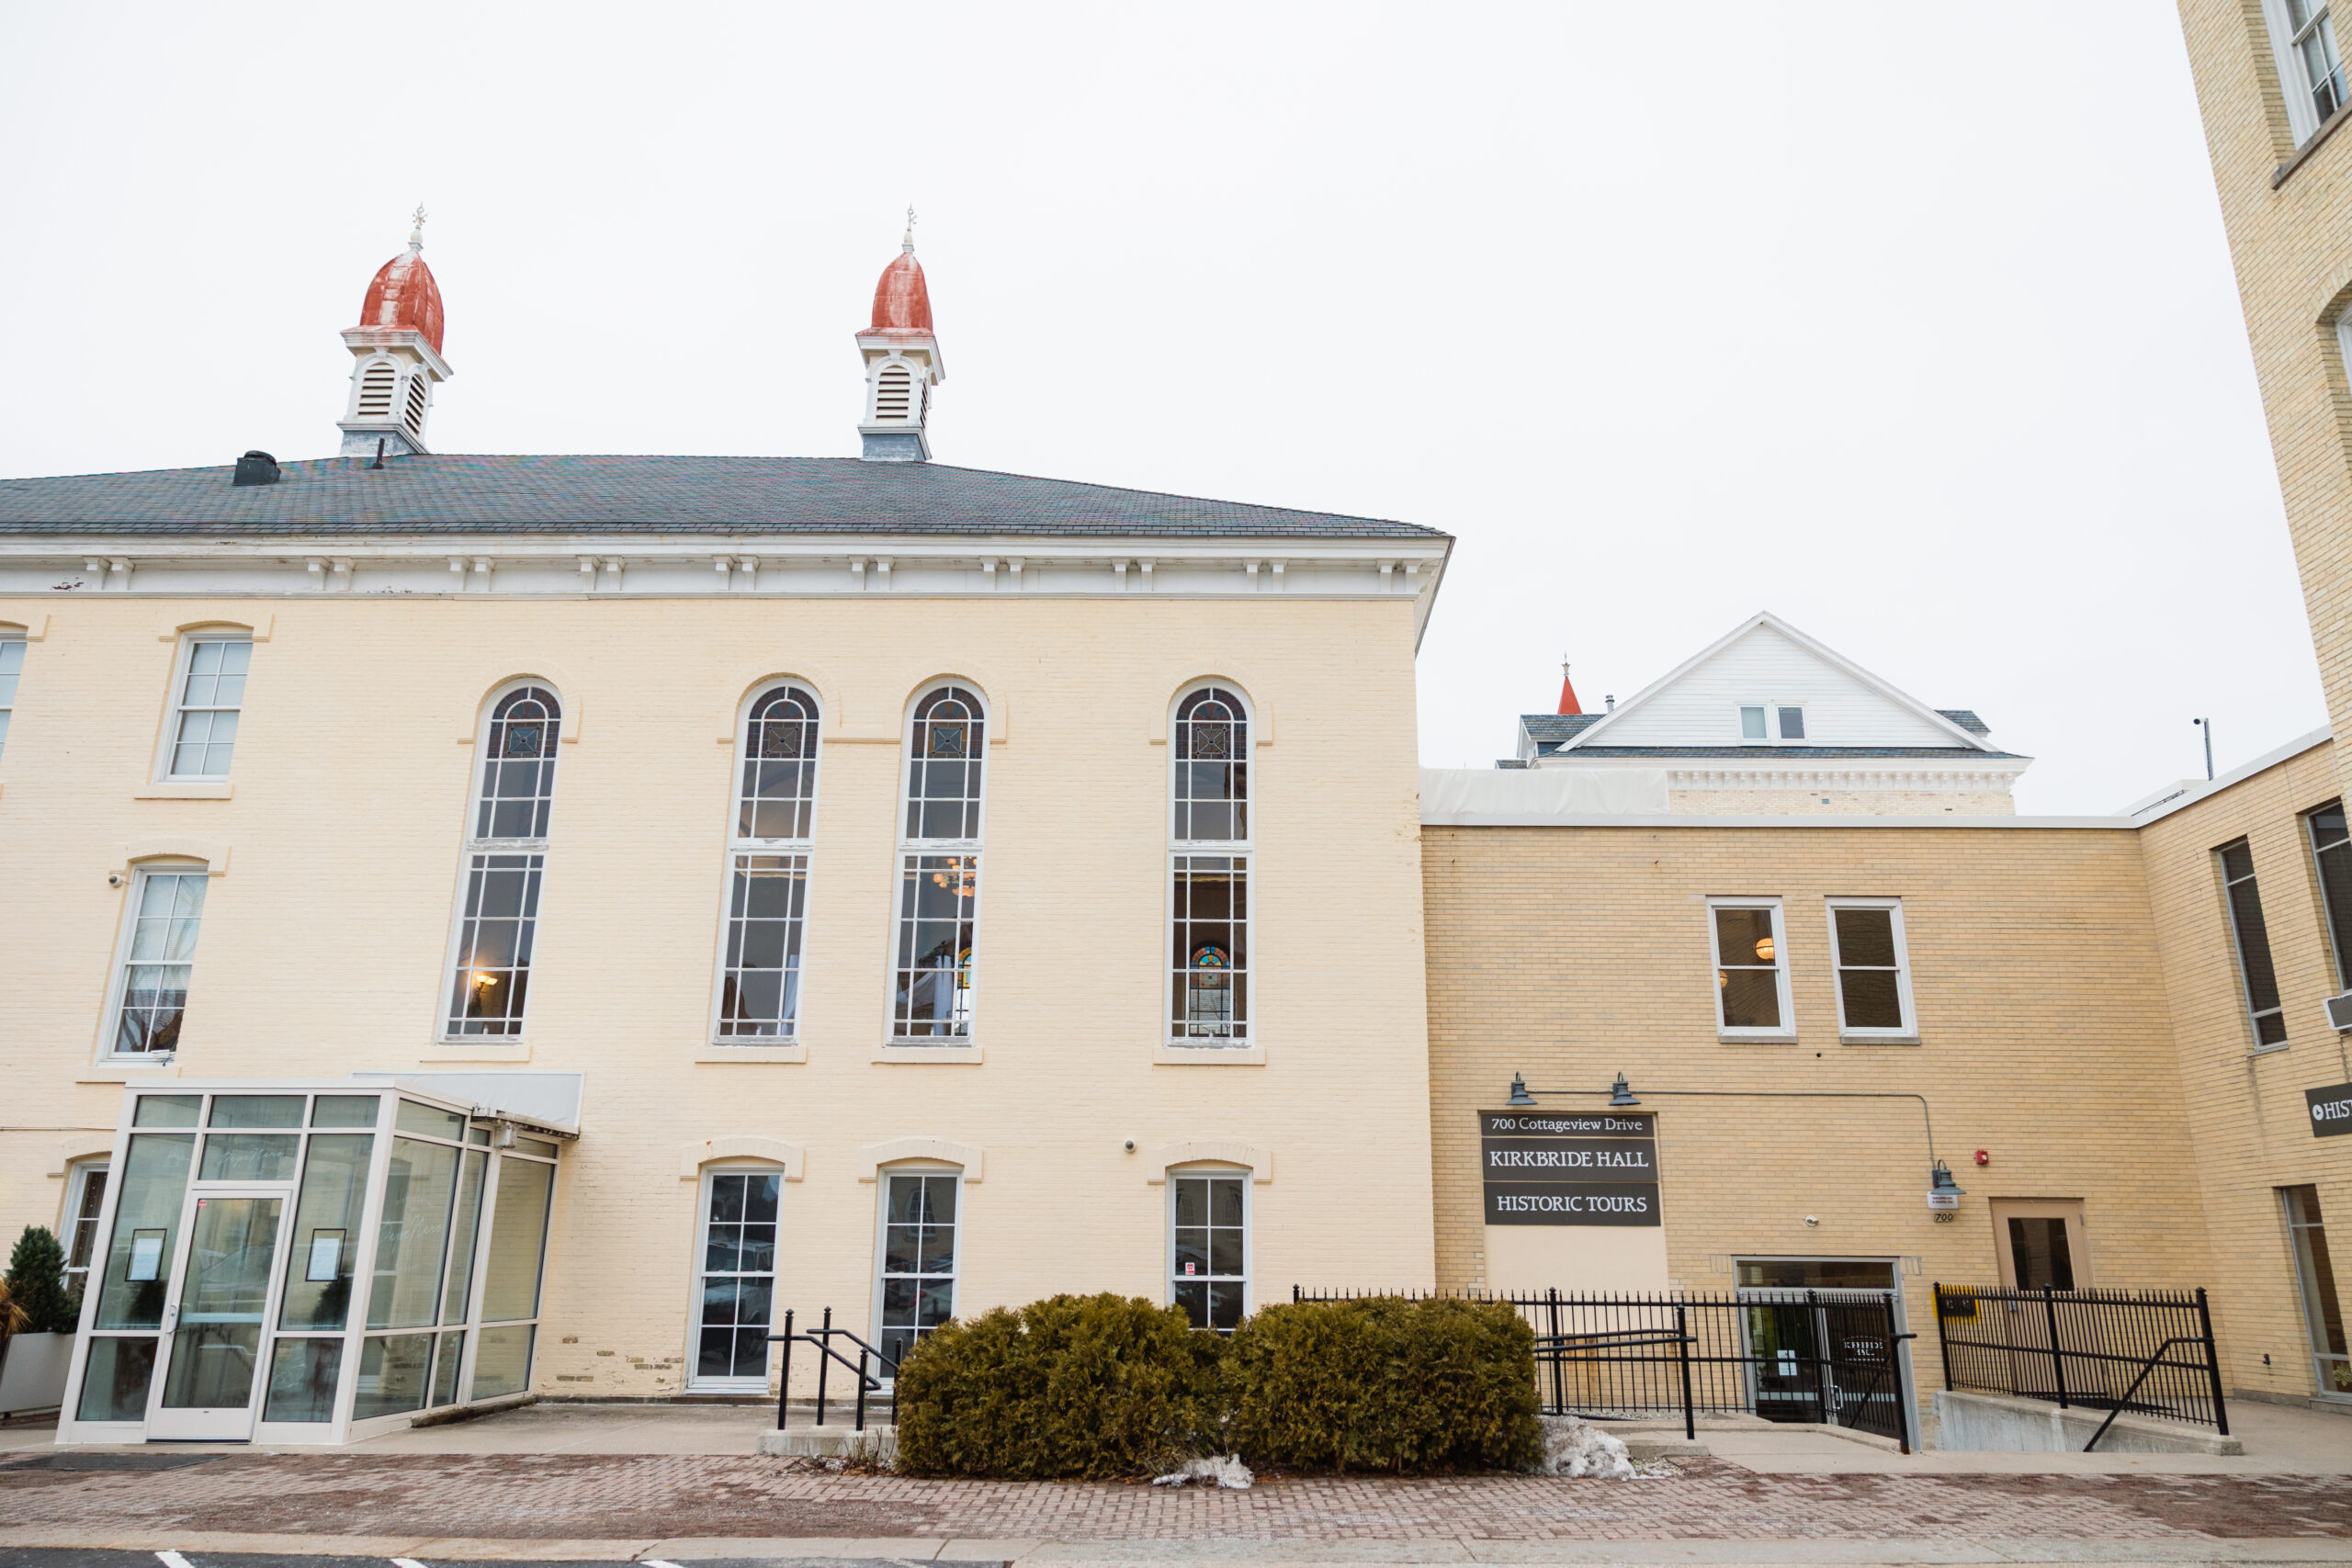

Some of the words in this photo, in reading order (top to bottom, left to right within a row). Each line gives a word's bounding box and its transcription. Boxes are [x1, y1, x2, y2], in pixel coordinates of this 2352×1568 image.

[1491, 1118, 1516, 1130] 700
[1519, 1117, 1601, 1133] Cottageview
[1604, 1118, 1643, 1131] Drive
[1489, 1151, 1593, 1168] KIRKBRIDE
[1596, 1151, 1649, 1168] HALL
[1497, 1196, 1582, 1212] HISTORIC
[1586, 1196, 1647, 1213] TOURS
[1935, 1213, 1954, 1222] 700
